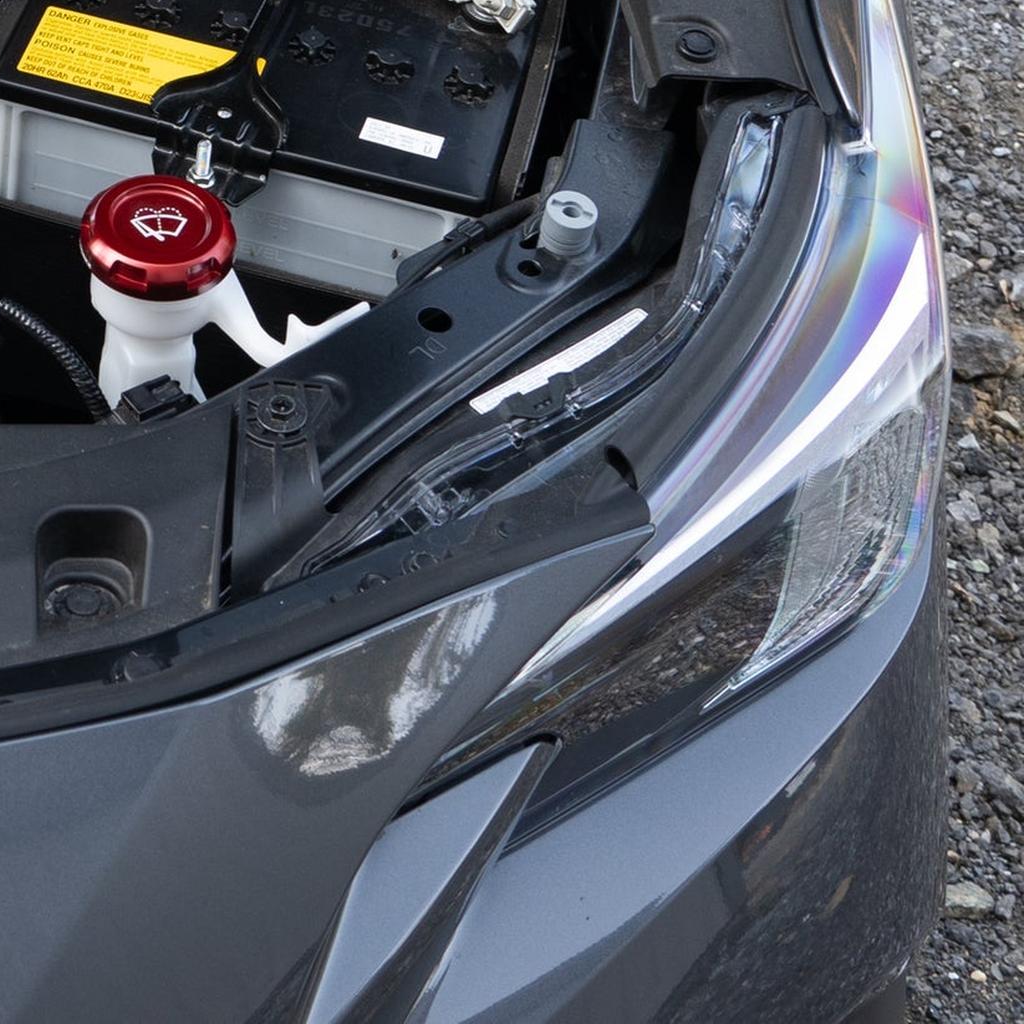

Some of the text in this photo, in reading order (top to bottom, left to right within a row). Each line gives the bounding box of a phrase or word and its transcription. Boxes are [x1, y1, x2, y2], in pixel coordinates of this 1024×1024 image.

[49, 9, 92, 25] DANGER
[34, 38, 76, 54] POISON
[39, 31, 55, 40] KEEP
[111, 48, 125, 57] AND
[26, 55, 43, 63] KEEP
[72, 75, 93, 86] CCA
